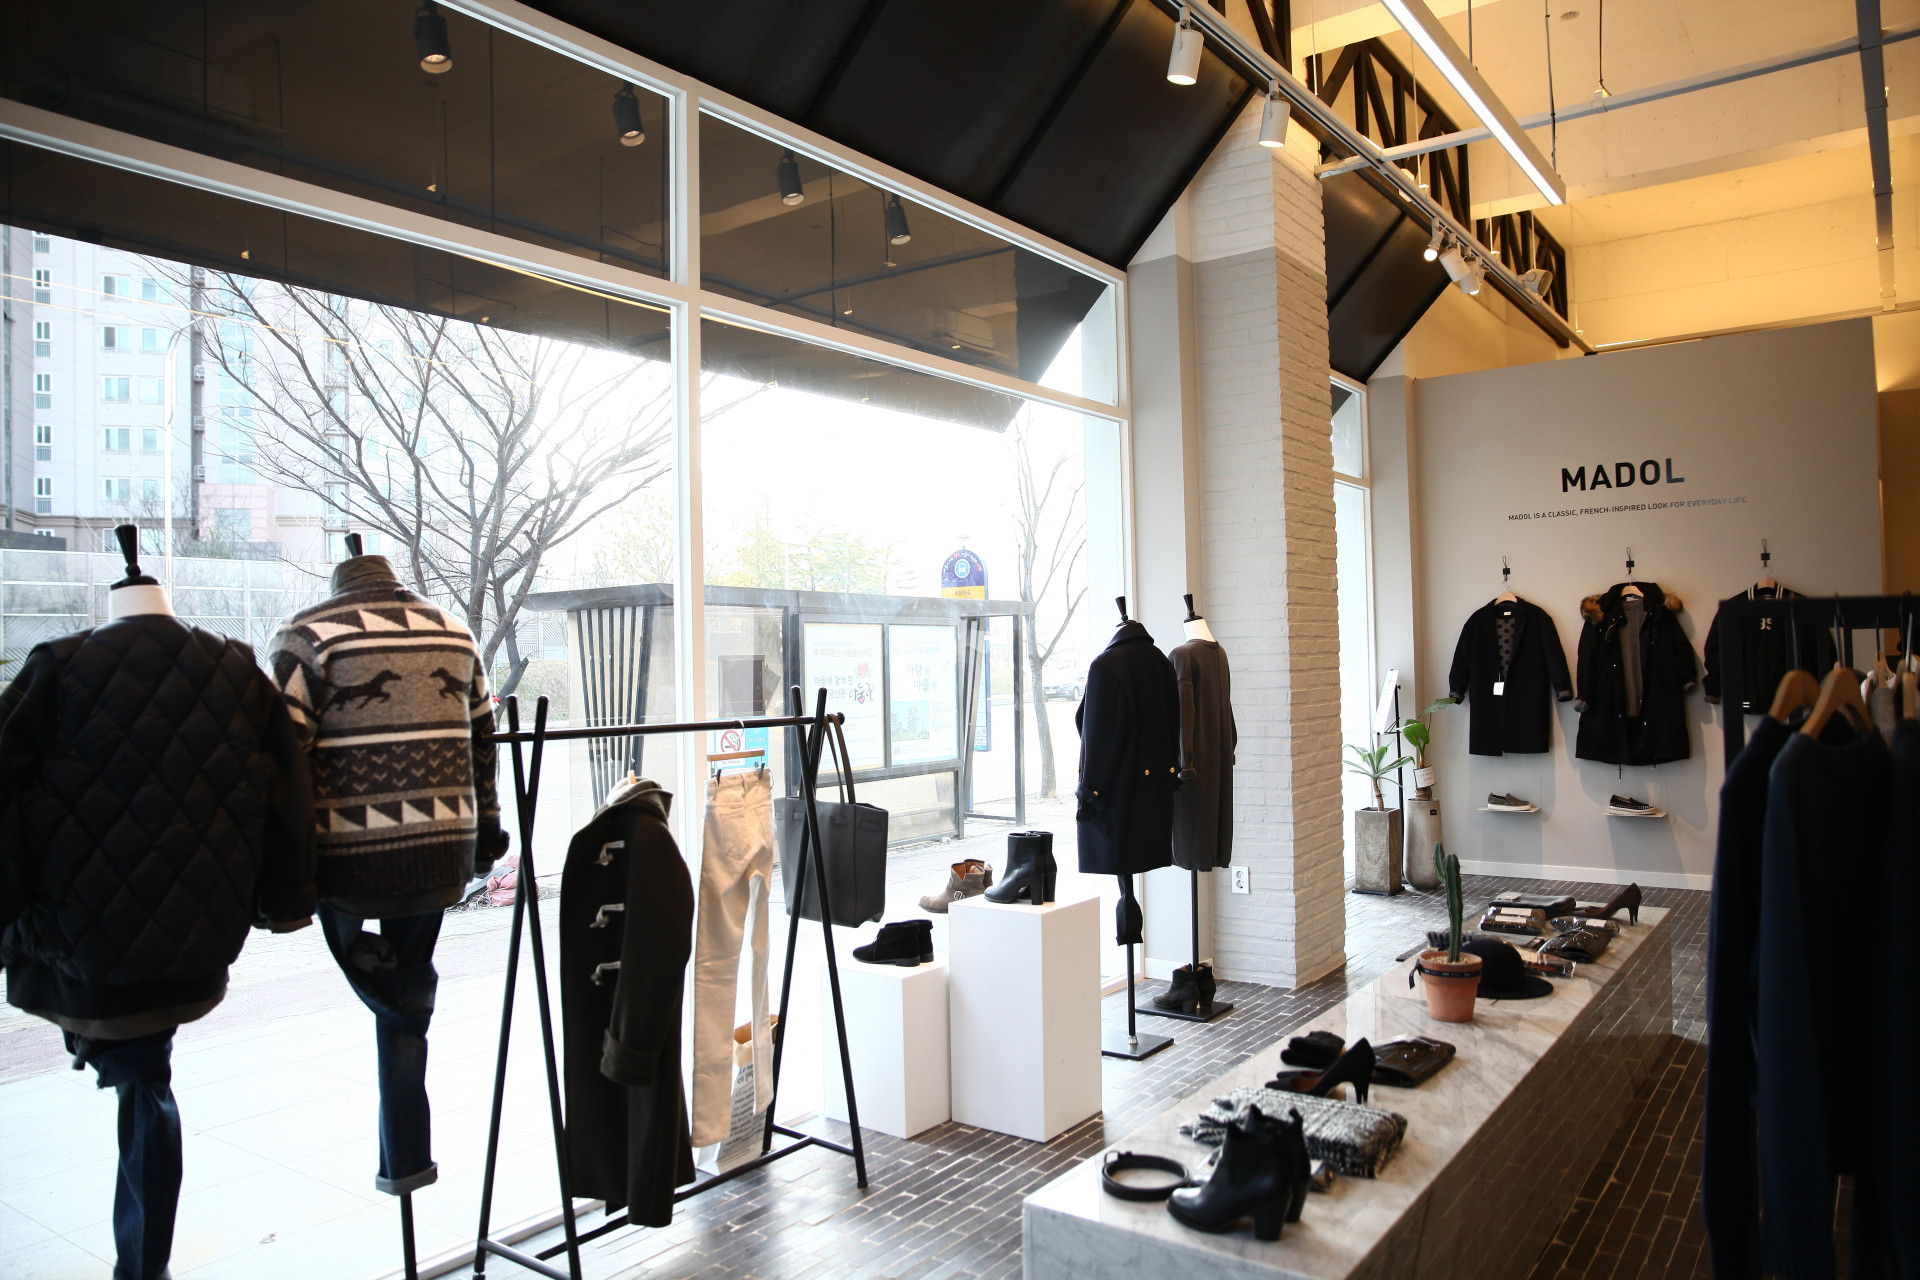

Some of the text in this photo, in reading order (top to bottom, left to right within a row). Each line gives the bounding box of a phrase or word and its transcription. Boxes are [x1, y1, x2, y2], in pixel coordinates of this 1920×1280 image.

[1561, 458, 1685, 492] MADOL
[1548, 509, 1578, 518] CLASSIC,
[1580, 504, 1646, 515] FRENCH-INSPIRED
[1687, 497, 1727, 507] EVERYDAY
[906, 662, 922, 677] 사람
[913, 678, 930, 692] 마을
